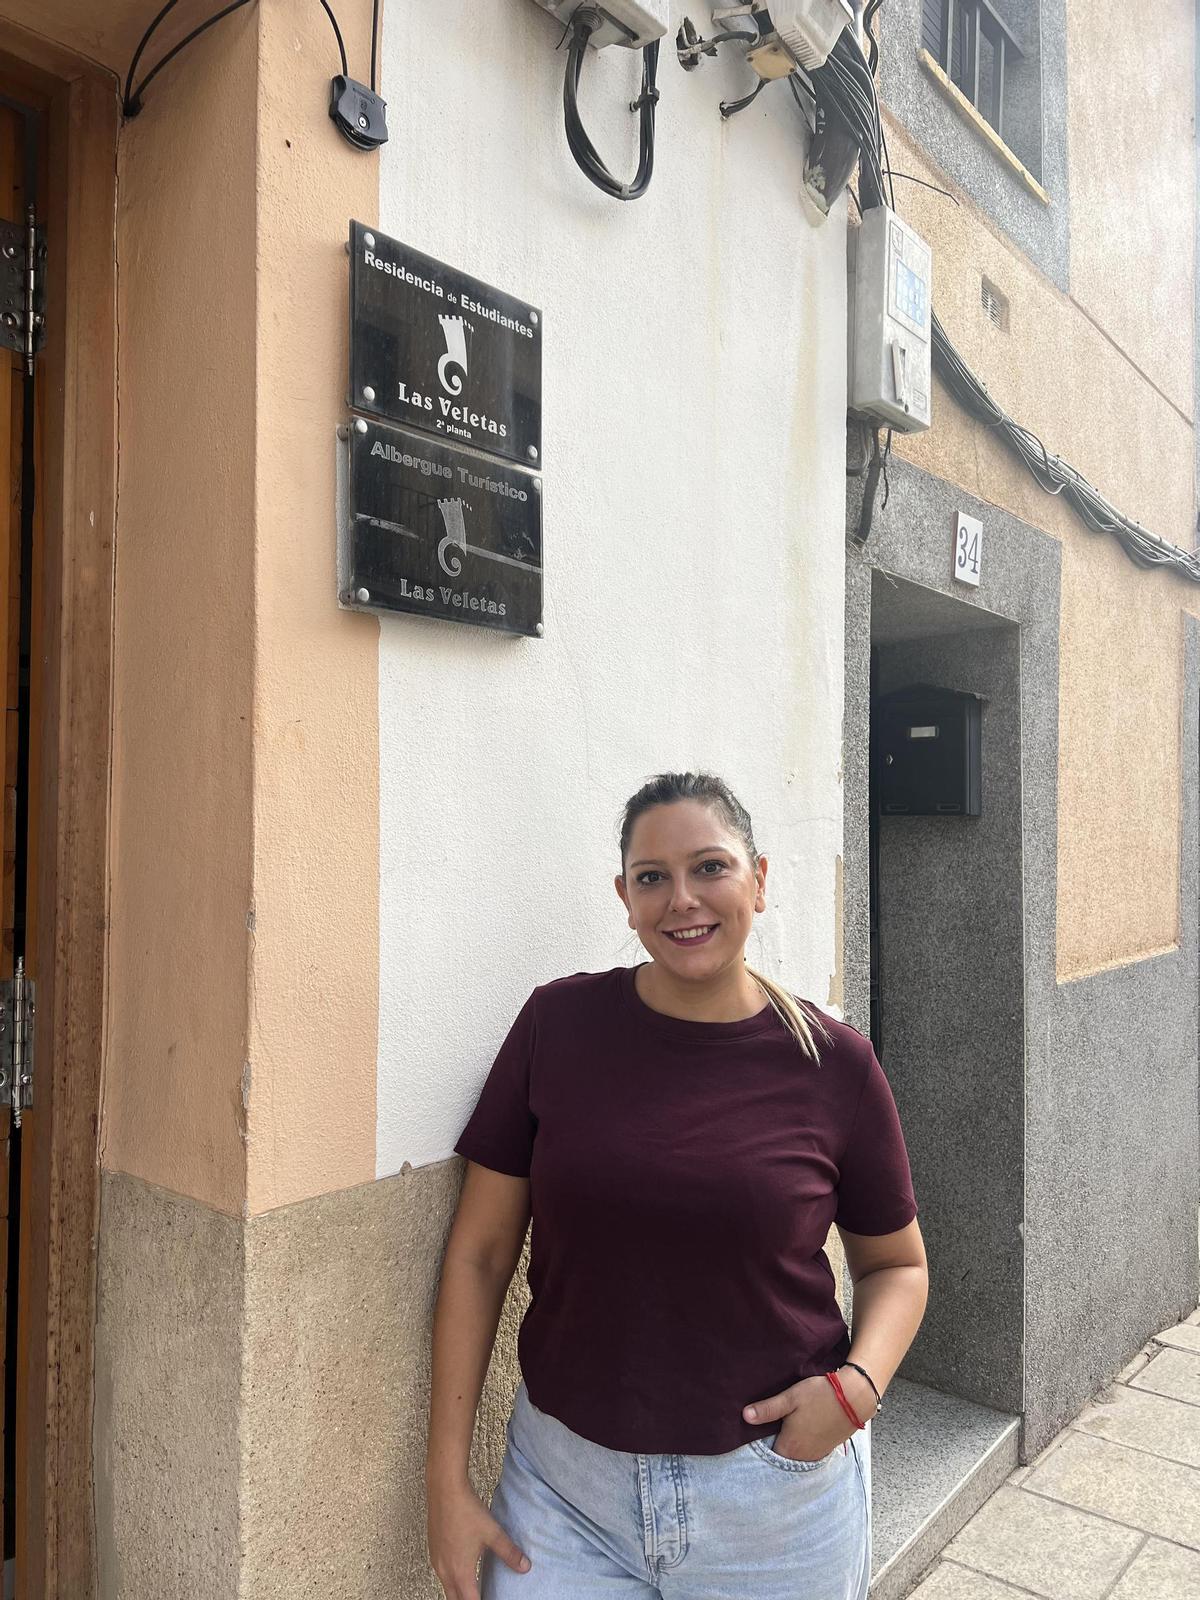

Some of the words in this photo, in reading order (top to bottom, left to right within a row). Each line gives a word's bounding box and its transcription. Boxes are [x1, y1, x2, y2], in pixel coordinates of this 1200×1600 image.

[364, 250, 444, 298] Residencia
[447, 292, 457, 304] de
[461, 294, 533, 338] Estudiantes
[398, 382, 433, 411] Las
[438, 396, 507, 437] Veletas
[446, 424, 472, 439] planta
[370, 441, 453, 479] Albergue
[457, 466, 528, 502] Turístico
[957, 526, 979, 575] 34
[400, 578, 434, 602] Las
[439, 585, 507, 616] Veletas
